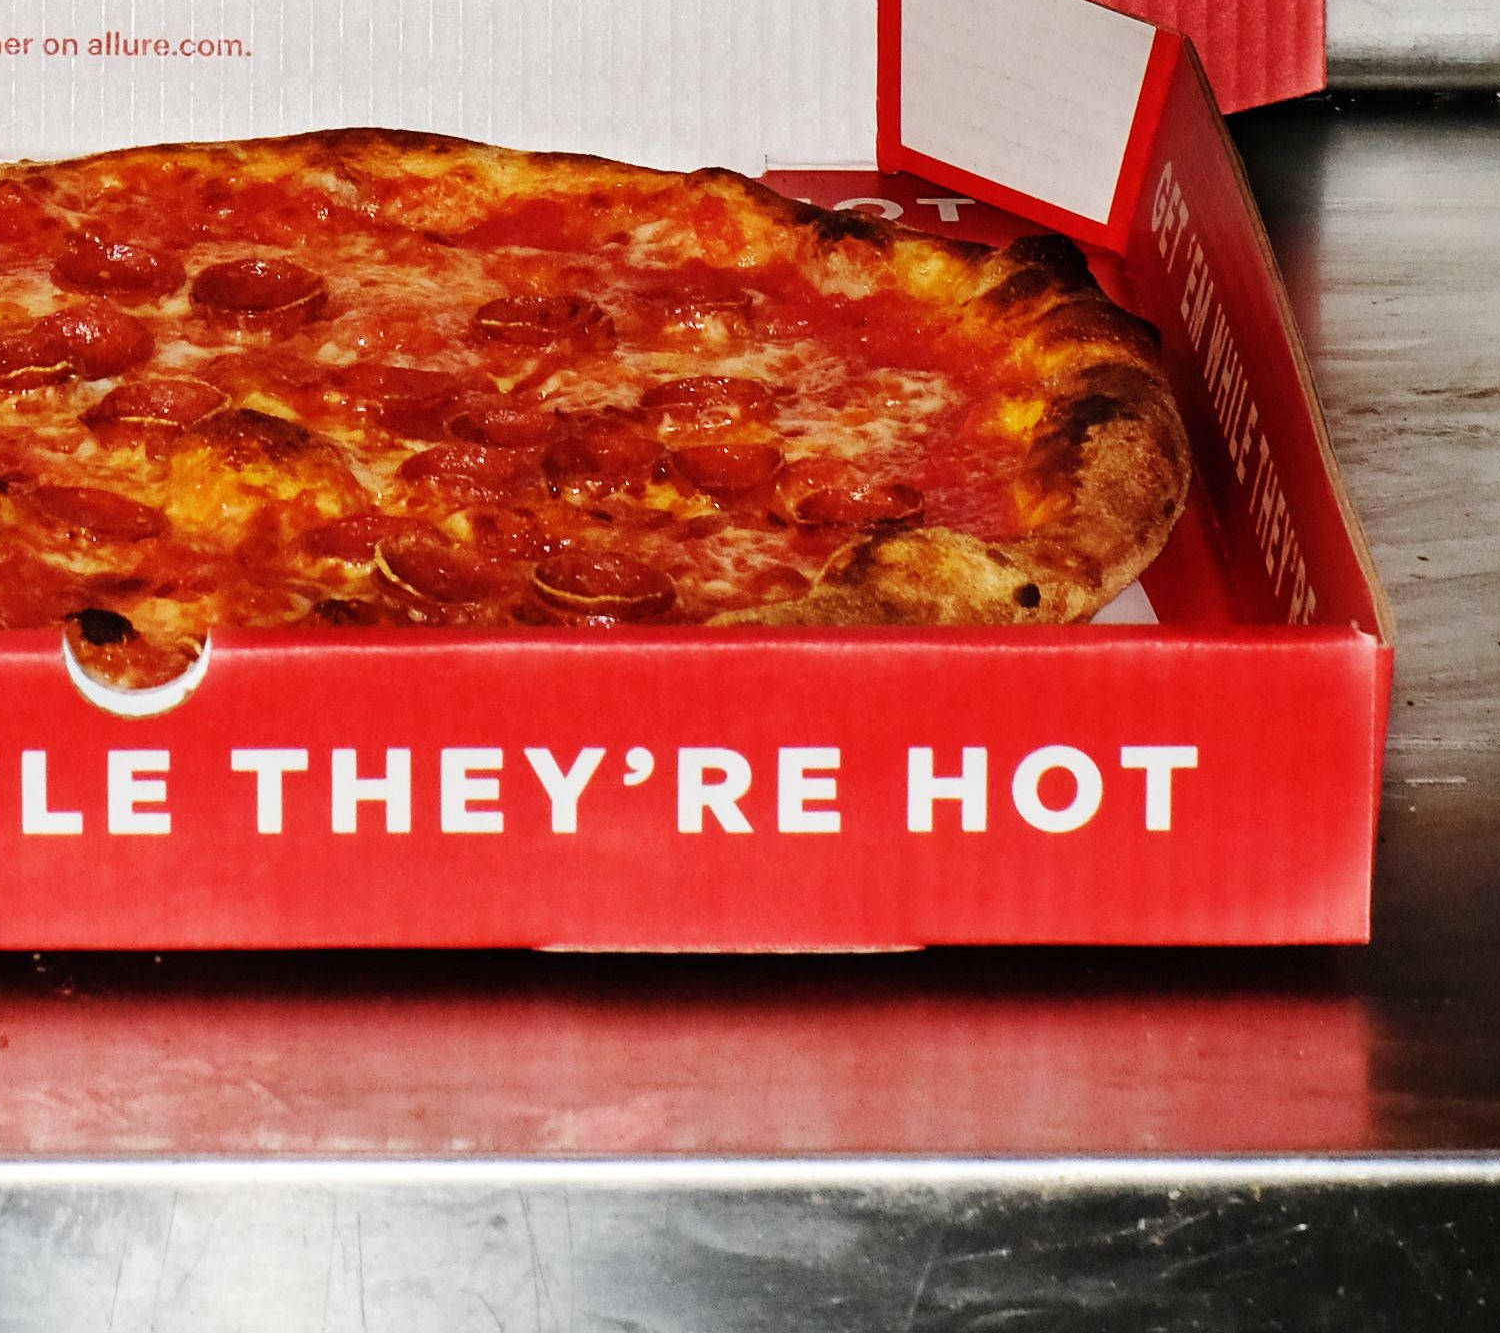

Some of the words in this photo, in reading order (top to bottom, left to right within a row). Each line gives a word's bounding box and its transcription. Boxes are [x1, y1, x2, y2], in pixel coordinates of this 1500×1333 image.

[42, 37, 79, 55] on
[87, 31, 253, 57] allure.com.
[1151, 161, 1190, 275] GET
[1204, 303, 1260, 485] WHILE
[231, 747, 841, 834] THEY’RE
[907, 745, 1199, 834] HOT
